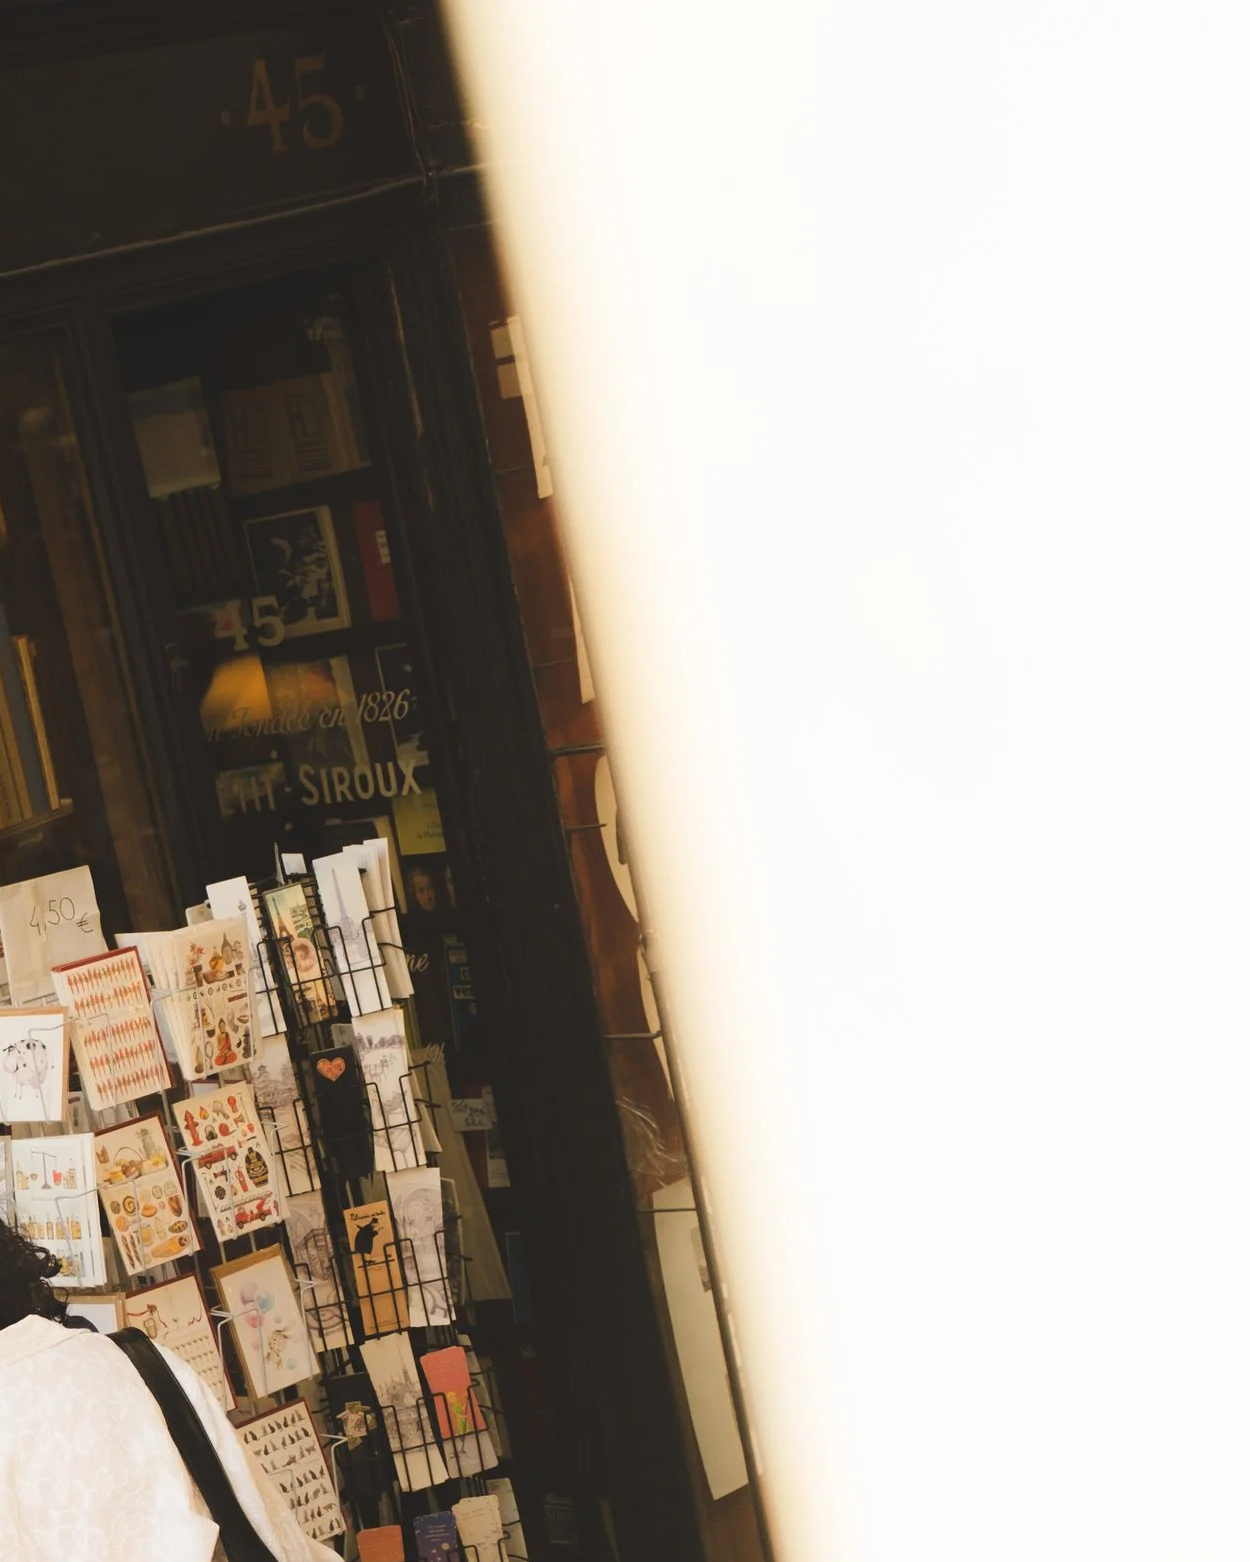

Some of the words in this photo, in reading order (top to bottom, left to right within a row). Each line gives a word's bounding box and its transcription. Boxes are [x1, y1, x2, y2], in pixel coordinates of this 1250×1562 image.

[213, 595, 286, 651] 45
[358, 689, 411, 725] 1826
[297, 758, 422, 806] SIROUX
[29, 897, 76, 936] 4,50
[76, 912, 94, 934] €
